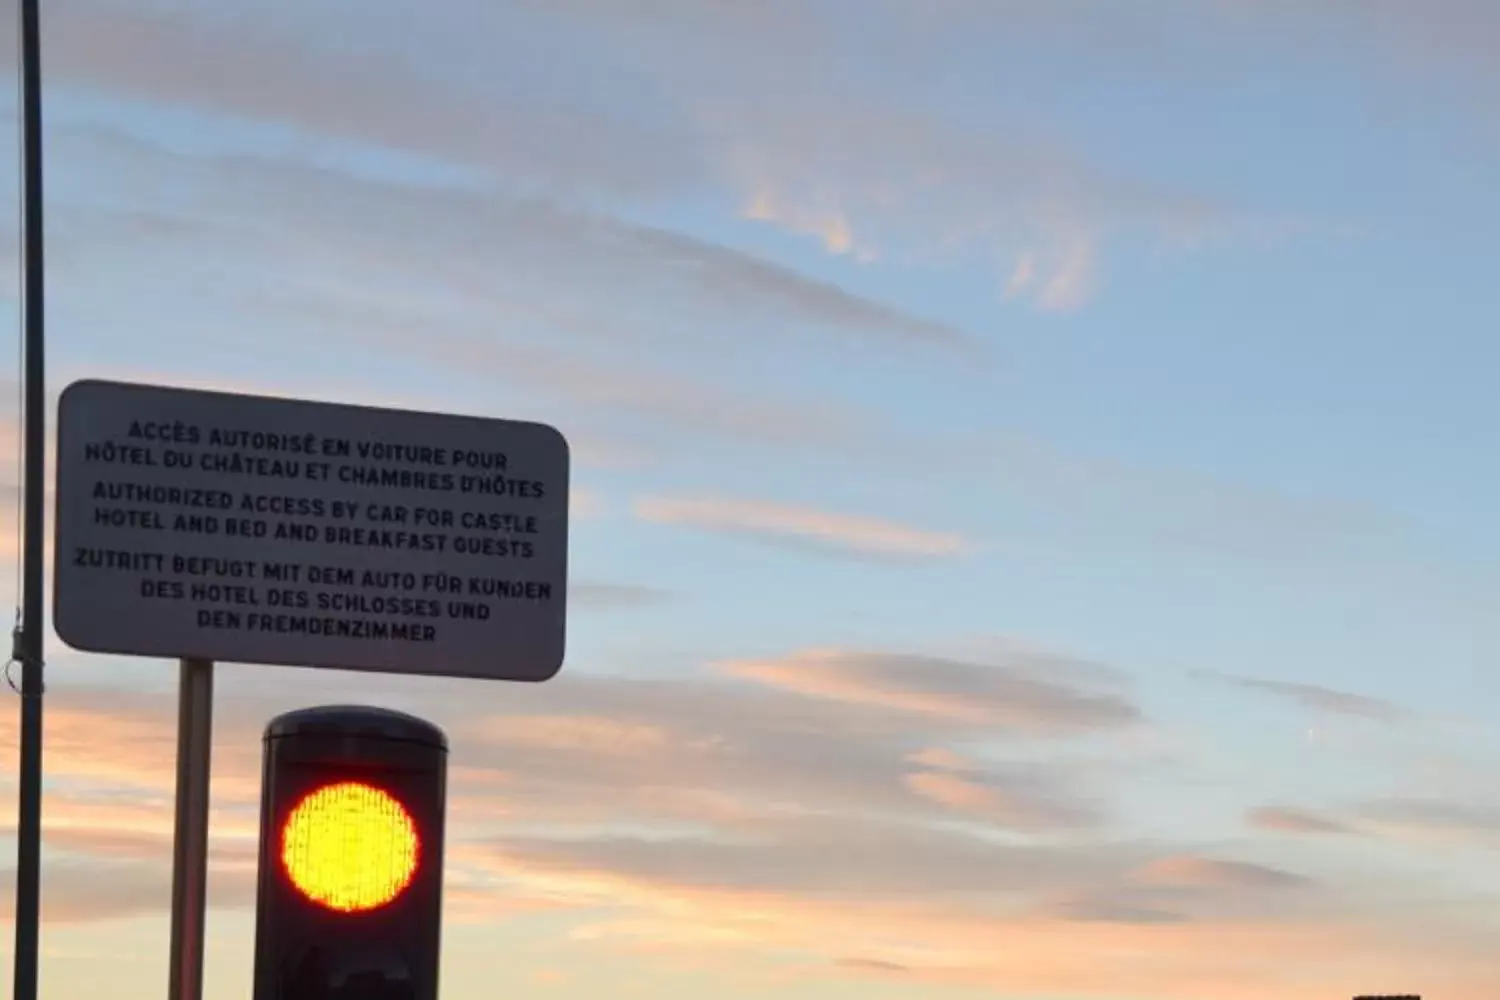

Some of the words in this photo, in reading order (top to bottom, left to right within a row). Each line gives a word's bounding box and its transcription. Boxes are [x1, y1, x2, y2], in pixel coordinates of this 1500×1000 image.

[84, 441, 157, 465] HÔTEL
[164, 450, 192, 468] DU
[201, 452, 299, 479] CHÂTEAU
[305, 462, 330, 482] ET
[338, 466, 454, 491] CHAMBRES
[128, 420, 200, 444] ACCÈS
[209, 428, 316, 454] AUTORISÉ
[322, 438, 349, 456] EN
[357, 440, 445, 465] VOITURE
[453, 449, 507, 471] POUR
[93, 481, 233, 509] AUTHORIZED
[241, 493, 325, 515] ACCESS
[332, 501, 359, 520] BY
[367, 505, 408, 524] CAR
[415, 508, 454, 526] FOR
[461, 512, 538, 533] CASTLE
[94, 508, 164, 529] HOTEL
[173, 514, 218, 534] AND
[226, 519, 266, 538] BED
[275, 523, 318, 543] AND
[325, 526, 447, 552] BREAKFAST
[454, 536, 534, 558] GUESTS
[73, 548, 163, 572] ZUTRITT
[173, 555, 256, 578] BEFUGT
[263, 561, 302, 582] MIT
[308, 566, 353, 585] DEM
[361, 569, 415, 590] AUTO
[423, 572, 462, 593] FÜR
[469, 577, 552, 600] KUNDEN
[141, 580, 184, 600] DES
[192, 583, 259, 605] HOTEL
[268, 589, 308, 608] DES
[317, 592, 441, 617] SCHLOSSES
[449, 603, 490, 620] UND
[198, 610, 240, 630] DEN
[247, 613, 436, 642] FREMDENZIMMER
